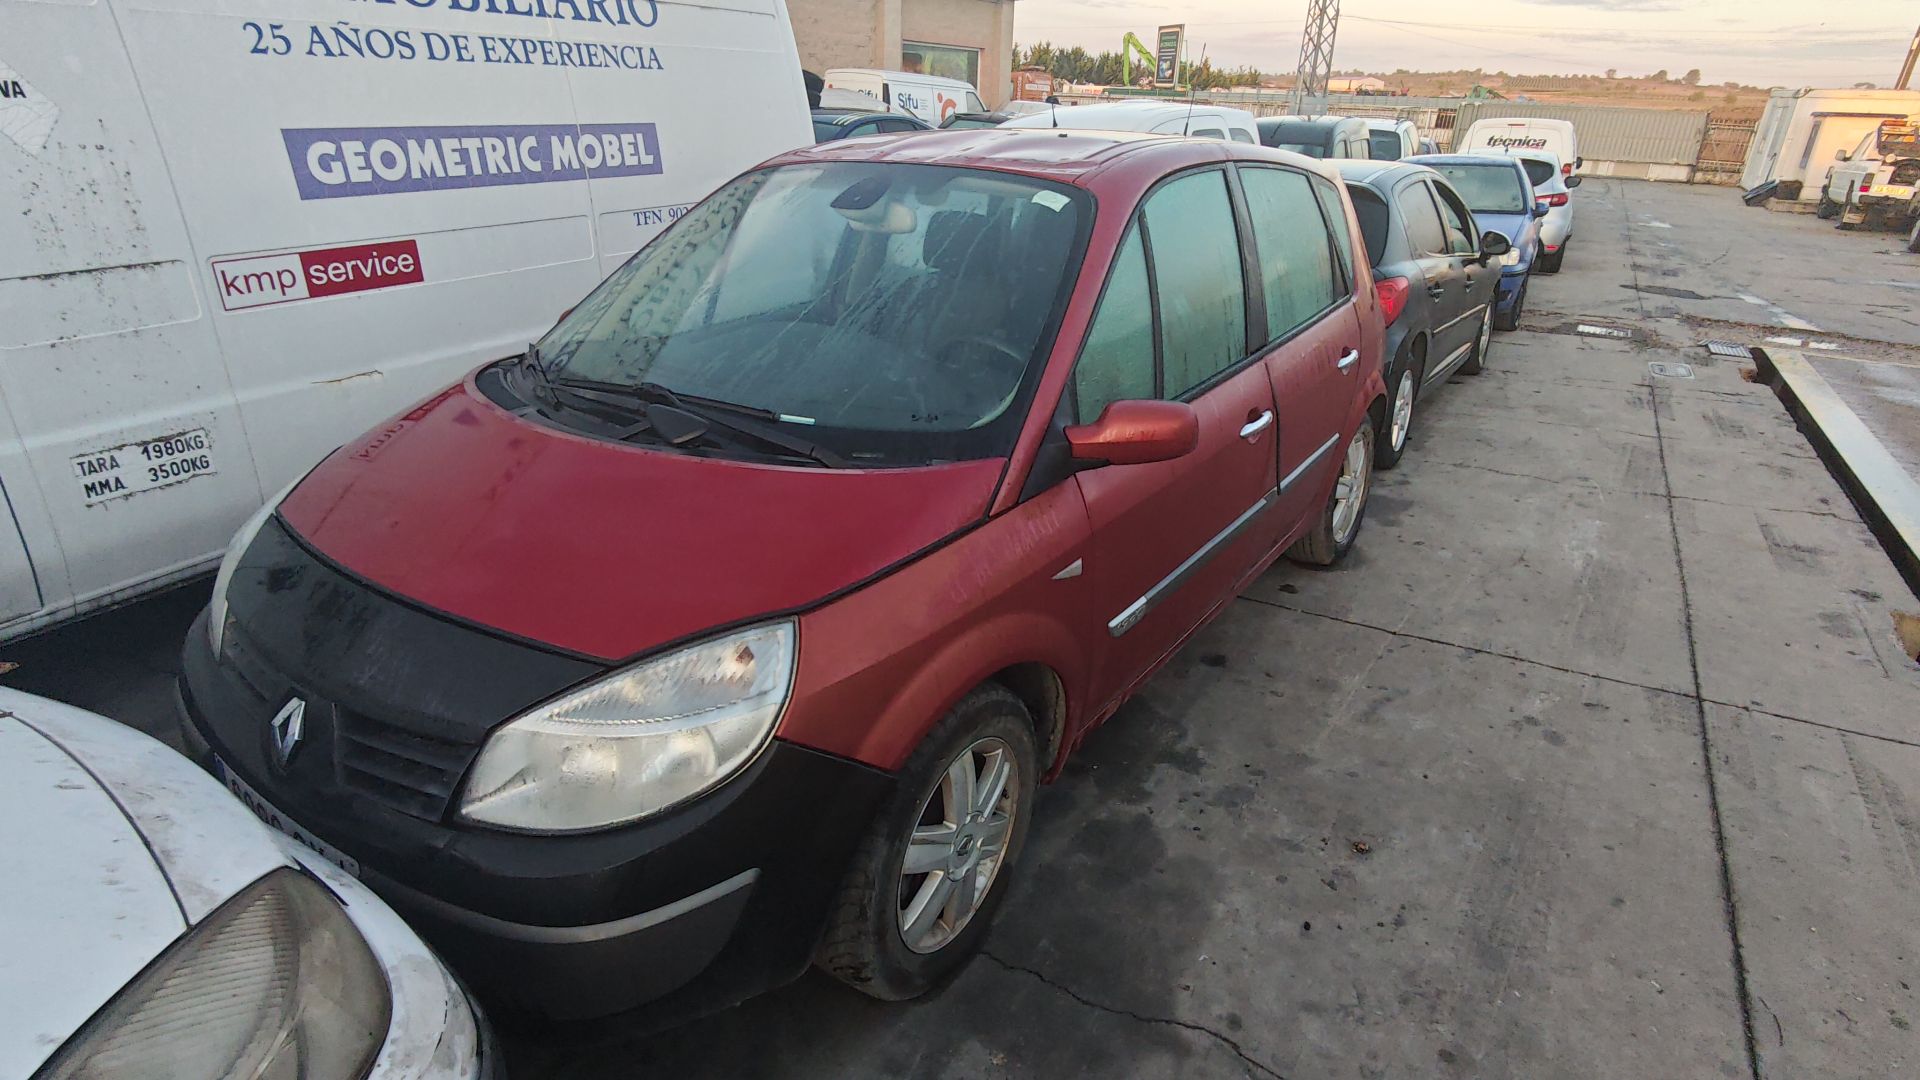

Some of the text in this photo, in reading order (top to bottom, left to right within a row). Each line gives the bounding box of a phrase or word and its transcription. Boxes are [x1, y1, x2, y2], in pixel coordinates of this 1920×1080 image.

[243, 21, 664, 70] 25 AÑOS DE EXPERIENCIA
[898, 93, 919, 110] Sifu
[306, 132, 654, 185] GEOMETRIC MOBEL
[633, 208, 663, 226] TFN
[220, 251, 415, 297] kmp service
[77, 434, 204, 477] TARA 1980KG
[84, 454, 210, 499] MMA 3500KG
